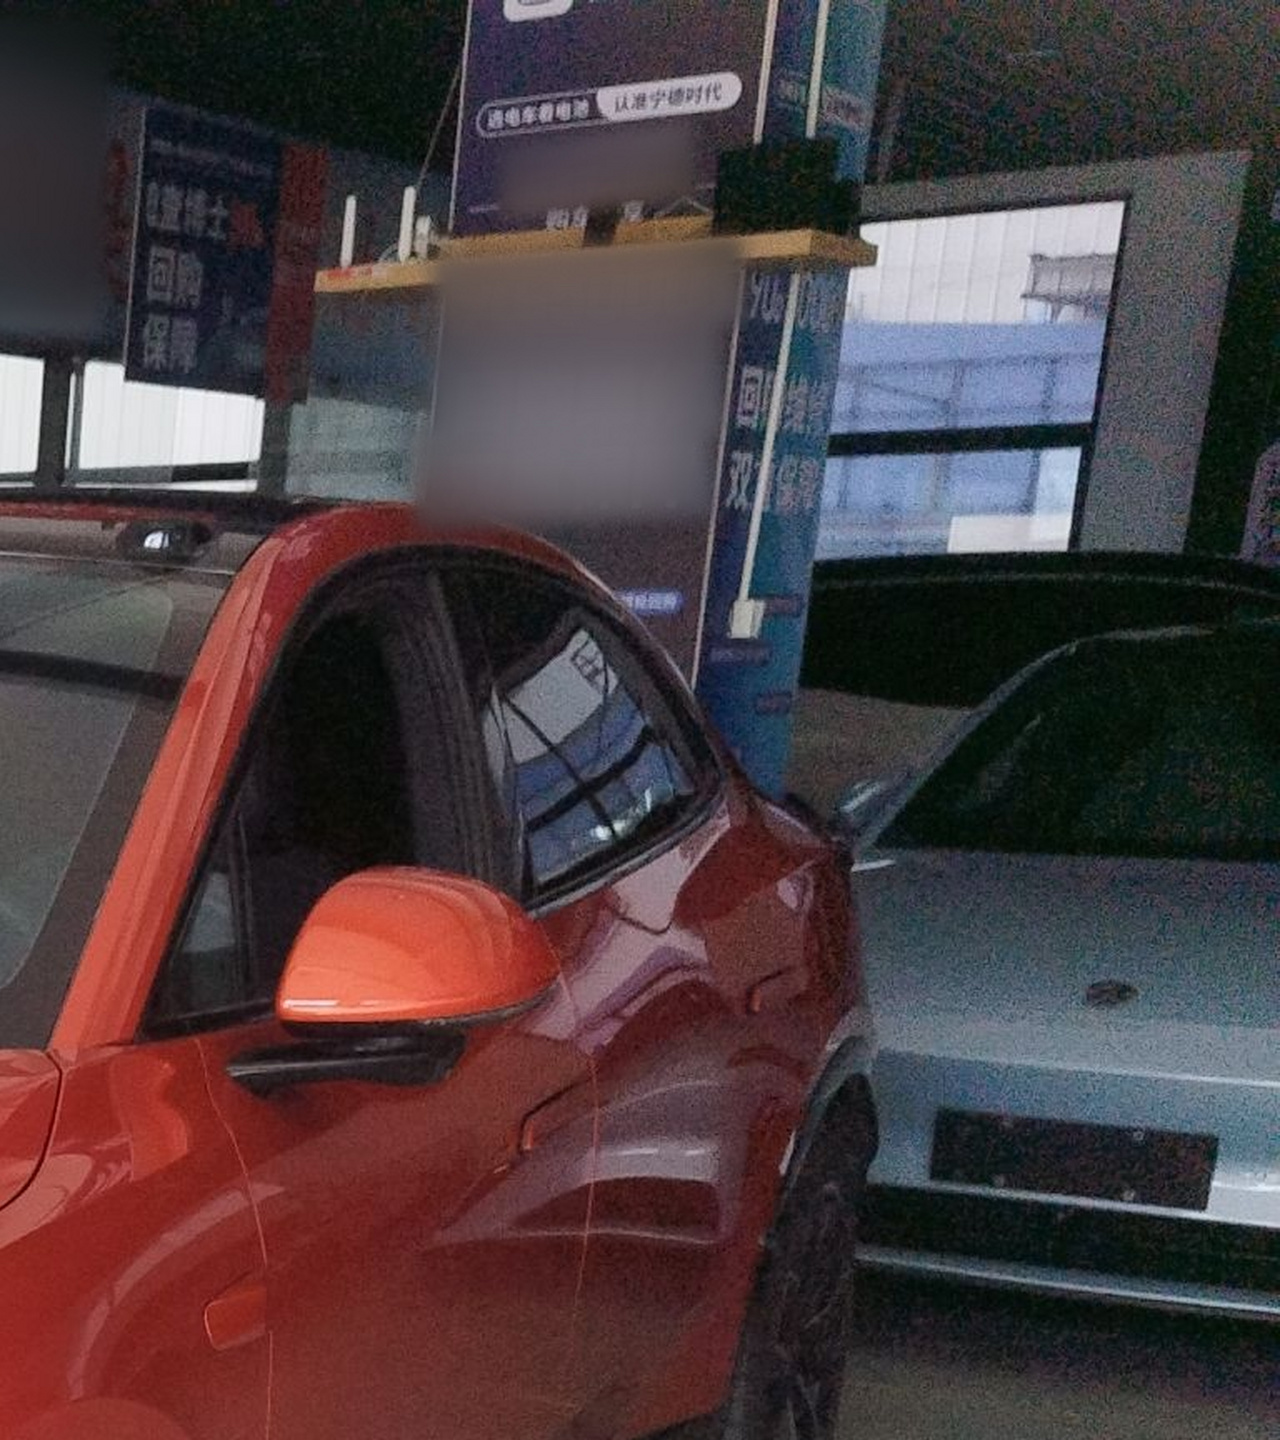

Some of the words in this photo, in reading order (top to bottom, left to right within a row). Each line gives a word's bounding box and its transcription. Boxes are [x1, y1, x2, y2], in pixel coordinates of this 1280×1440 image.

[614, 83, 722, 113] 认准宁德时代
